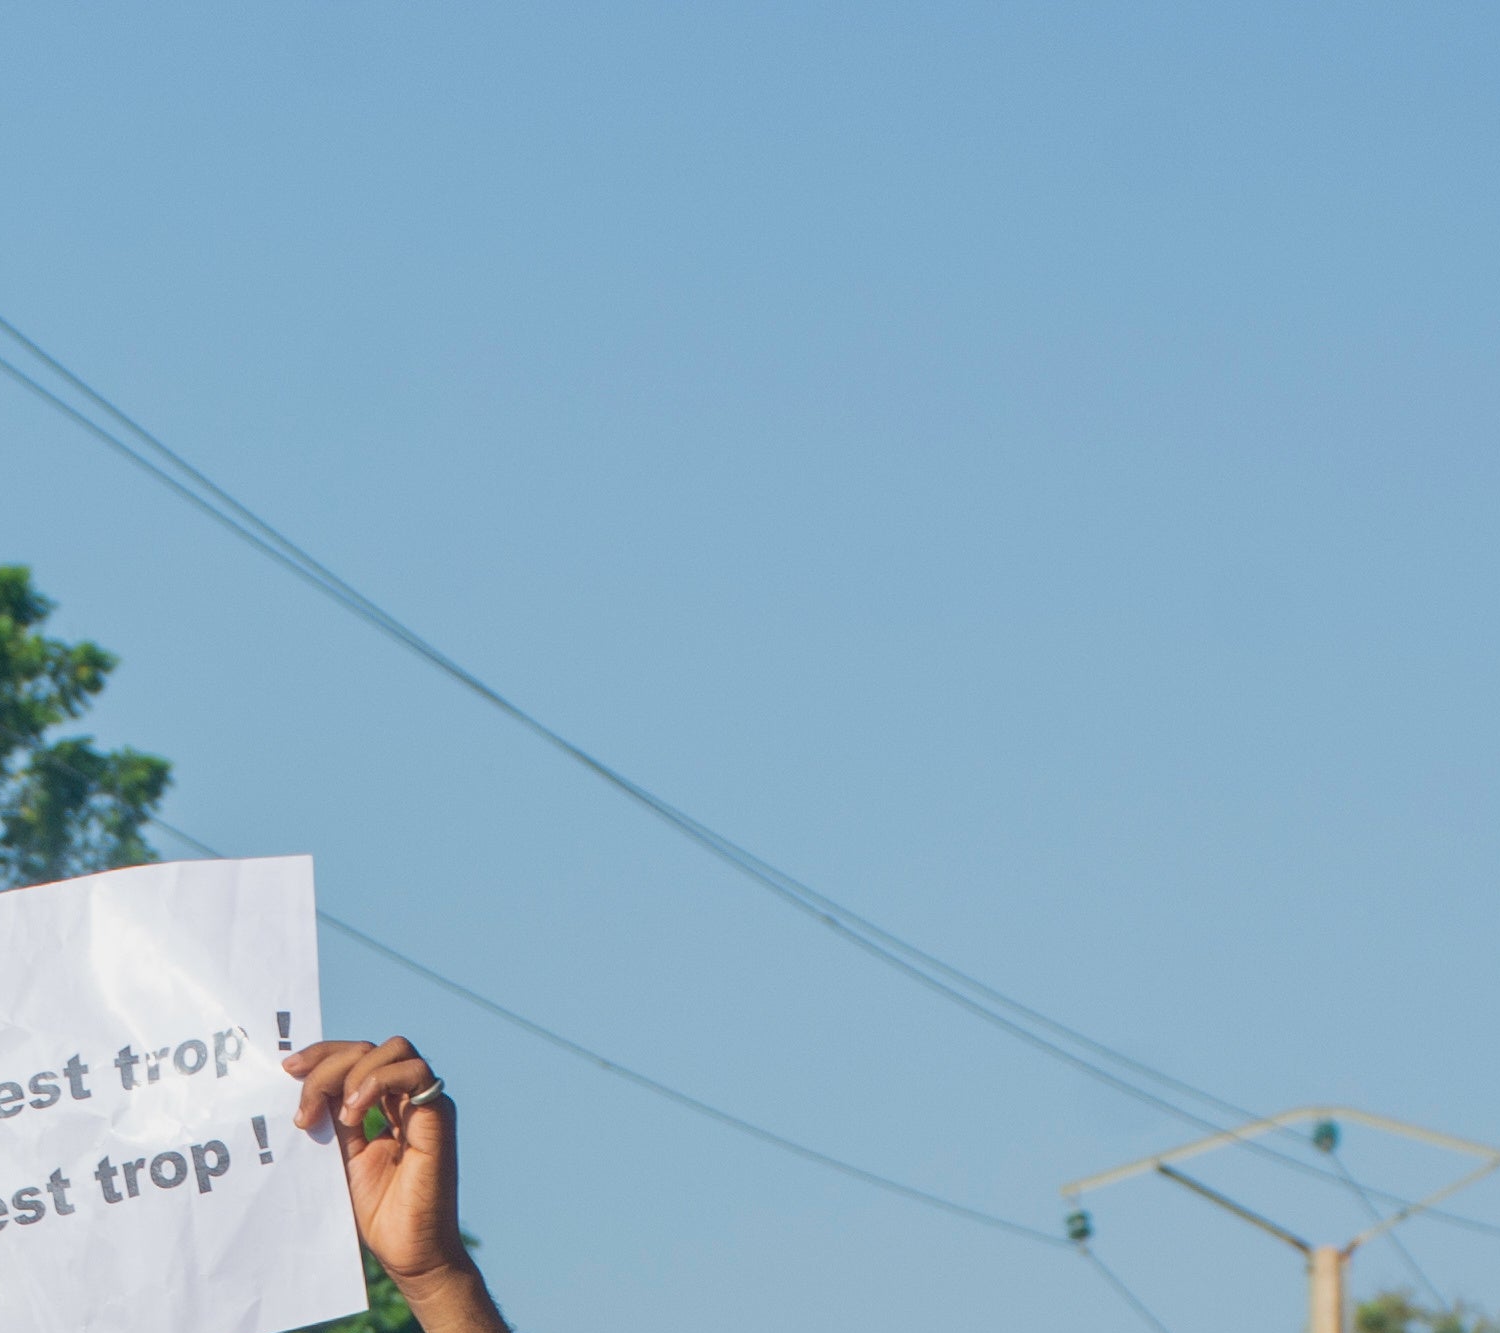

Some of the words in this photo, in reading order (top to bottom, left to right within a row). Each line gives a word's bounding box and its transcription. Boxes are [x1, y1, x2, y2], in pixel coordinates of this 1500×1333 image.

[113, 1024, 249, 1093] trop
[275, 1009, 294, 1052] !
[93, 1137, 233, 1206] trop
[248, 1114, 276, 1167] !
